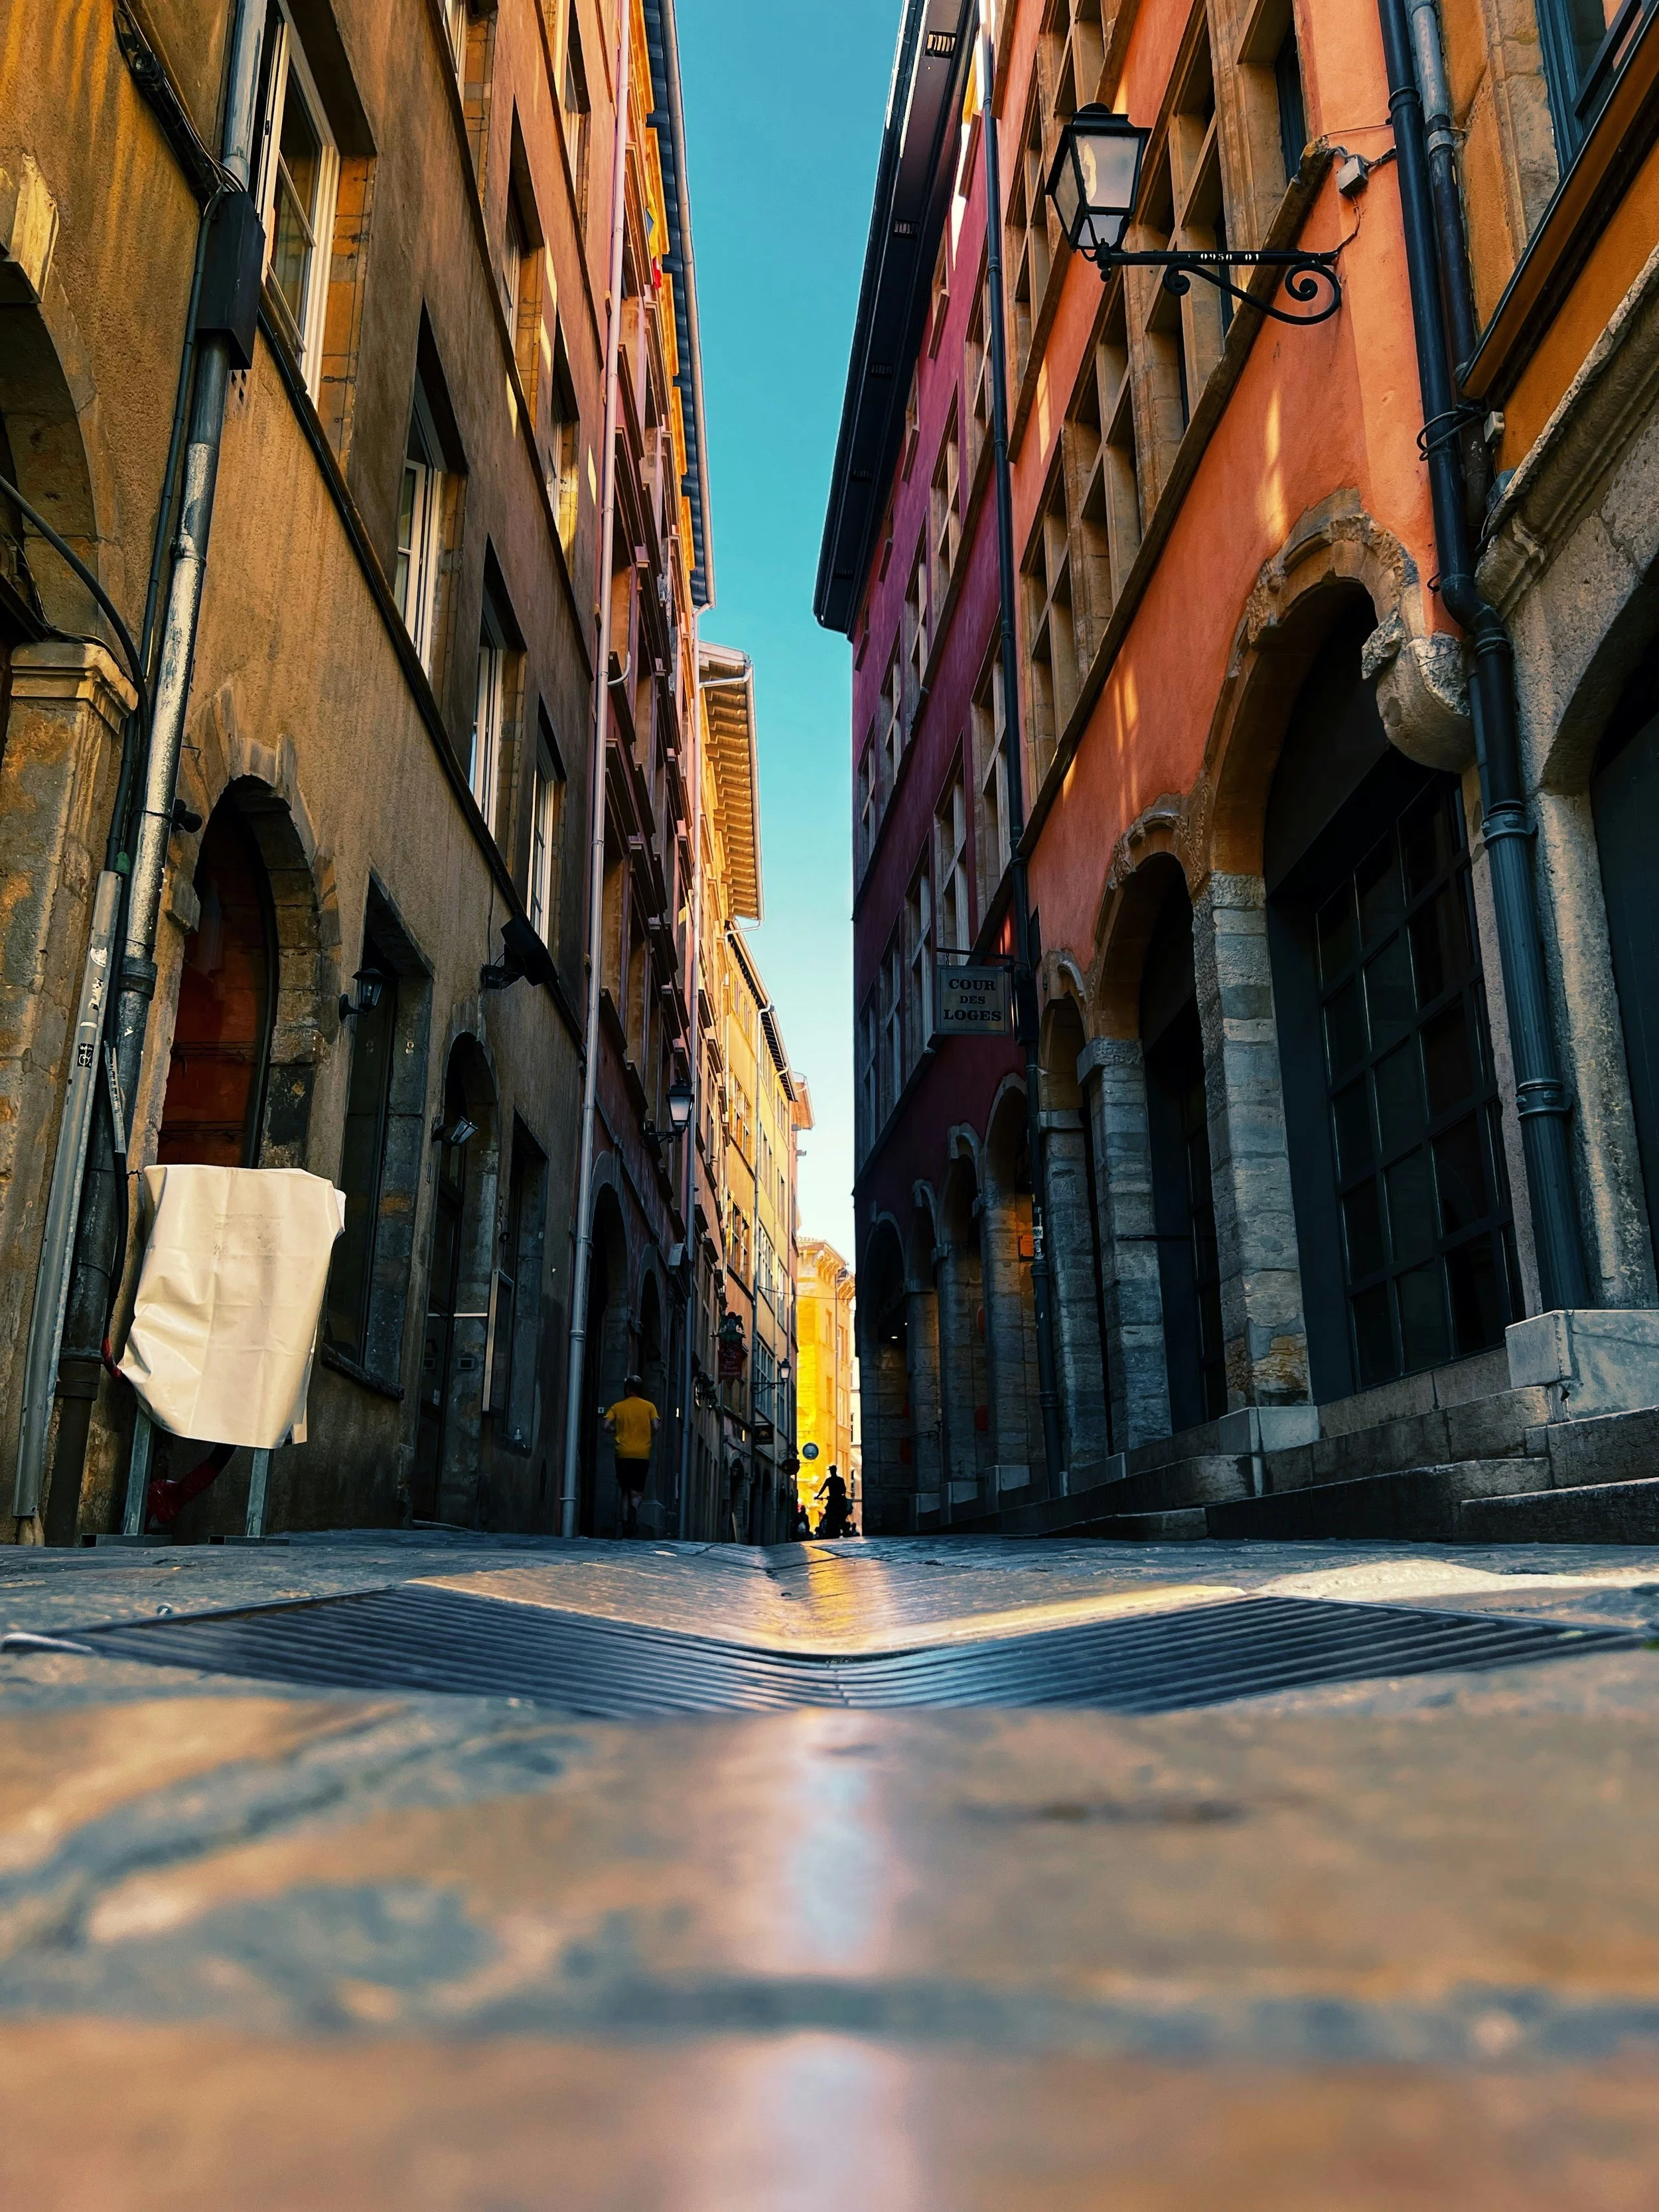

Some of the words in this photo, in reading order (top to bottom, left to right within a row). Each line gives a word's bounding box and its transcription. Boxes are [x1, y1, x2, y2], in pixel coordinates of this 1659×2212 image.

[948, 979, 996, 990] COUR
[960, 995, 985, 1004] DES
[944, 1009, 1001, 1021] LOGES
